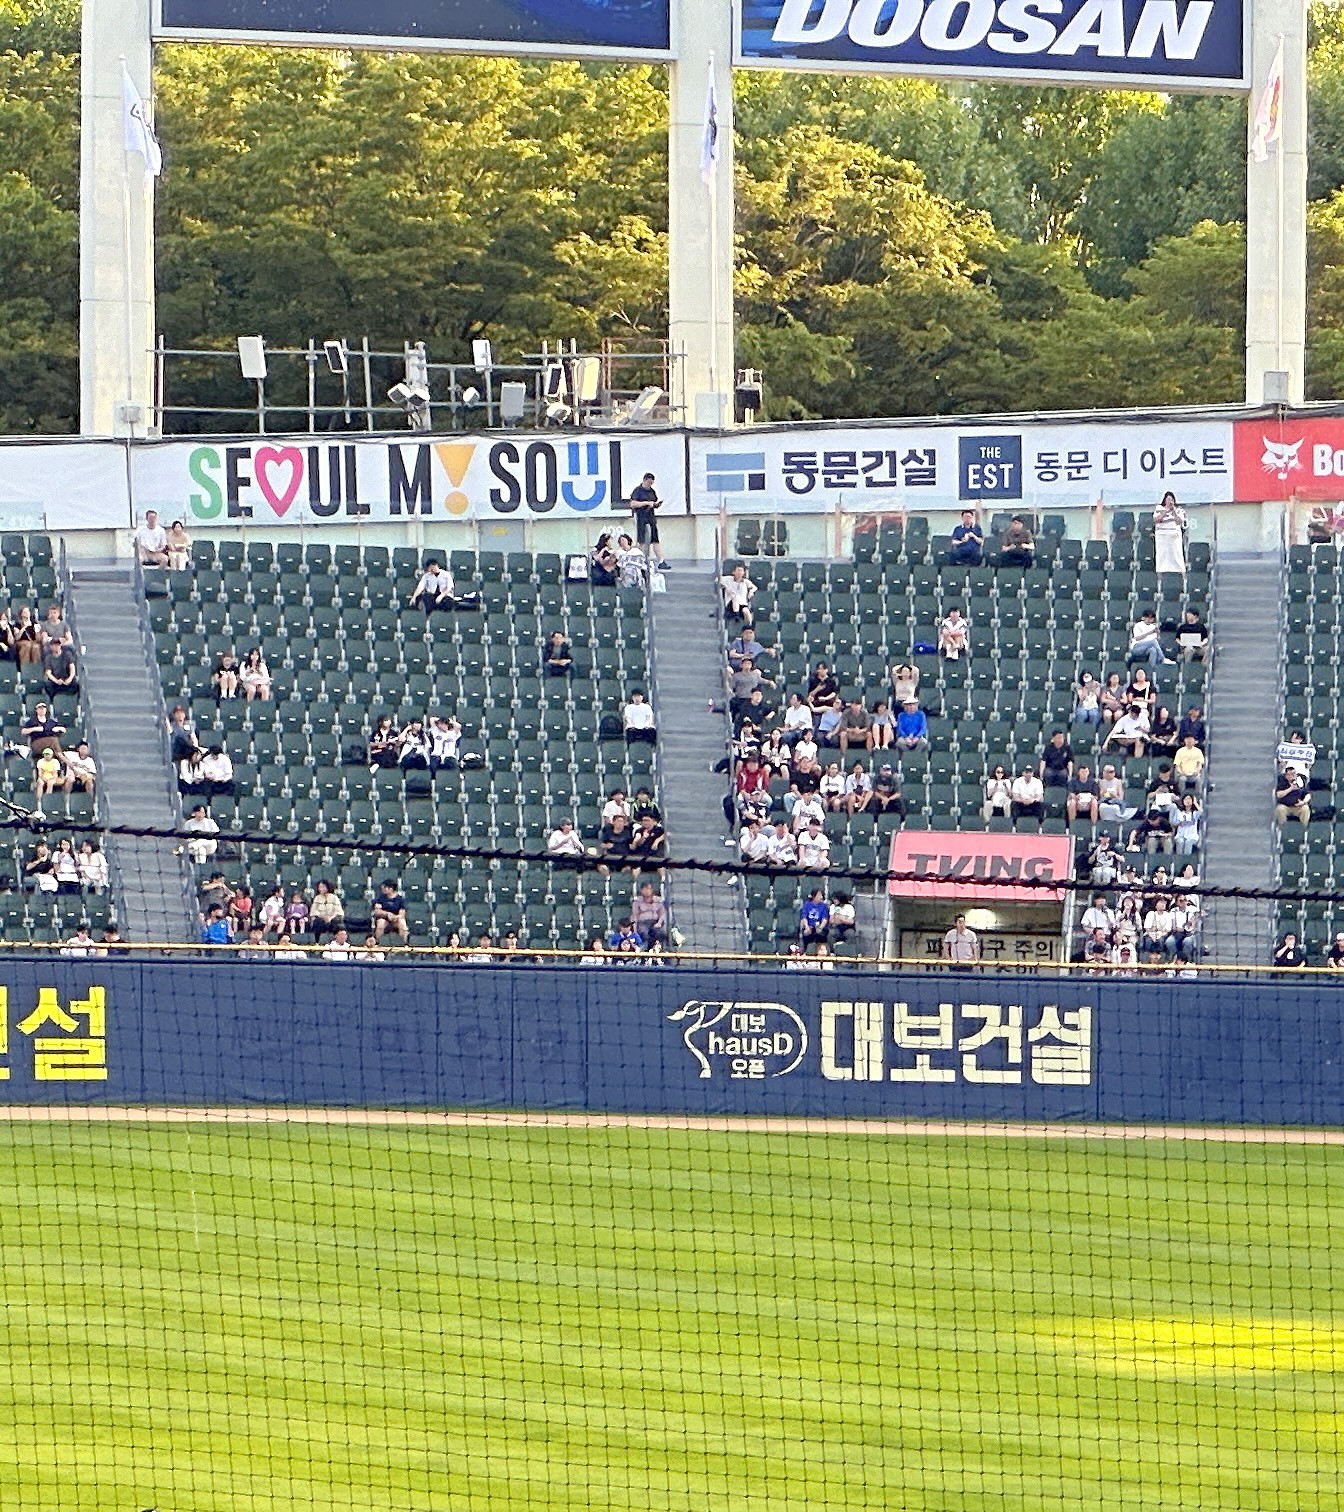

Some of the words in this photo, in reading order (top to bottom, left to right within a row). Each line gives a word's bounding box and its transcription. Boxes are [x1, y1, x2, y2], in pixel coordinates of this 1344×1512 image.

[773, 0, 1214, 60] DOOSAN
[979, 446, 1001, 459] THE
[1033, 451, 1093, 482] 동문
[1103, 449, 1136, 480] 디
[1139, 446, 1228, 478] 이스트
[781, 448, 937, 493] 동문건설
[967, 464, 1014, 489] EST
[907, 853, 1054, 881] TVING
[1015, 939, 1053, 961] 주의
[731, 1013, 766, 1033] 대보
[708, 1031, 793, 1056] hausD
[820, 1001, 1092, 1086] 대보건설
[730, 1058, 765, 1078] 오픈
